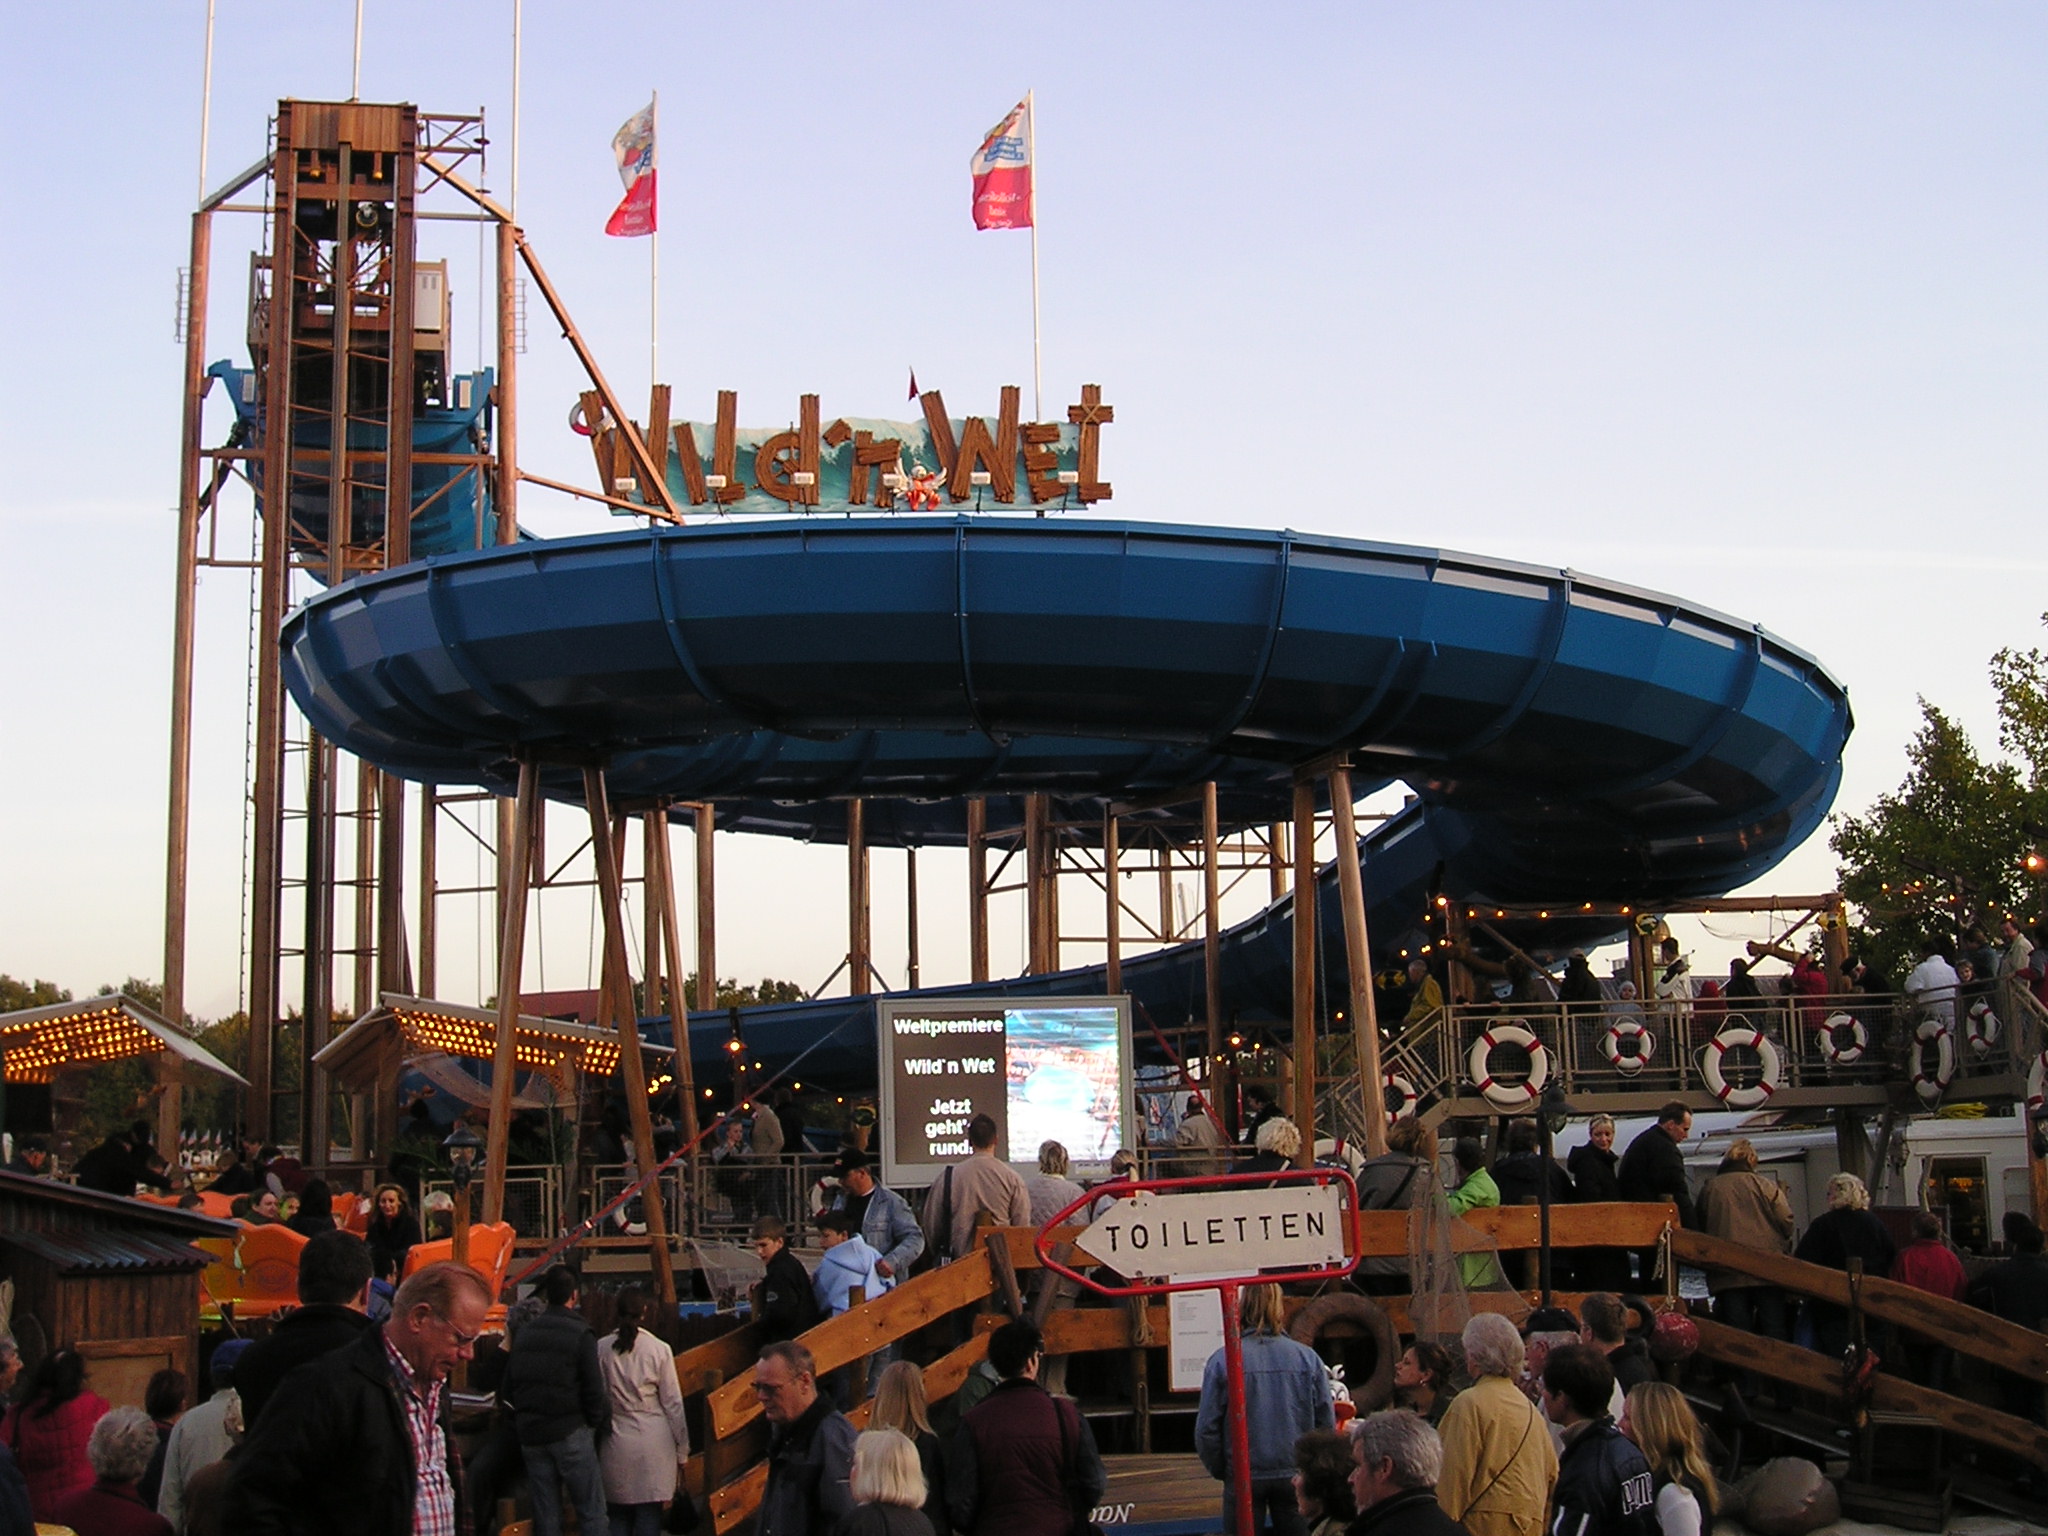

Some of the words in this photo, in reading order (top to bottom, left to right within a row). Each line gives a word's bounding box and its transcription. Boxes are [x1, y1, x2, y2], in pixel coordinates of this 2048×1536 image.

[893, 1018, 1004, 1038] Weltpremiere
[961, 1057, 996, 1074] Wet
[929, 1099, 972, 1115] Jetzt
[925, 1118, 971, 1139] geht'
[1105, 1211, 1325, 1252] TOILETTEN
